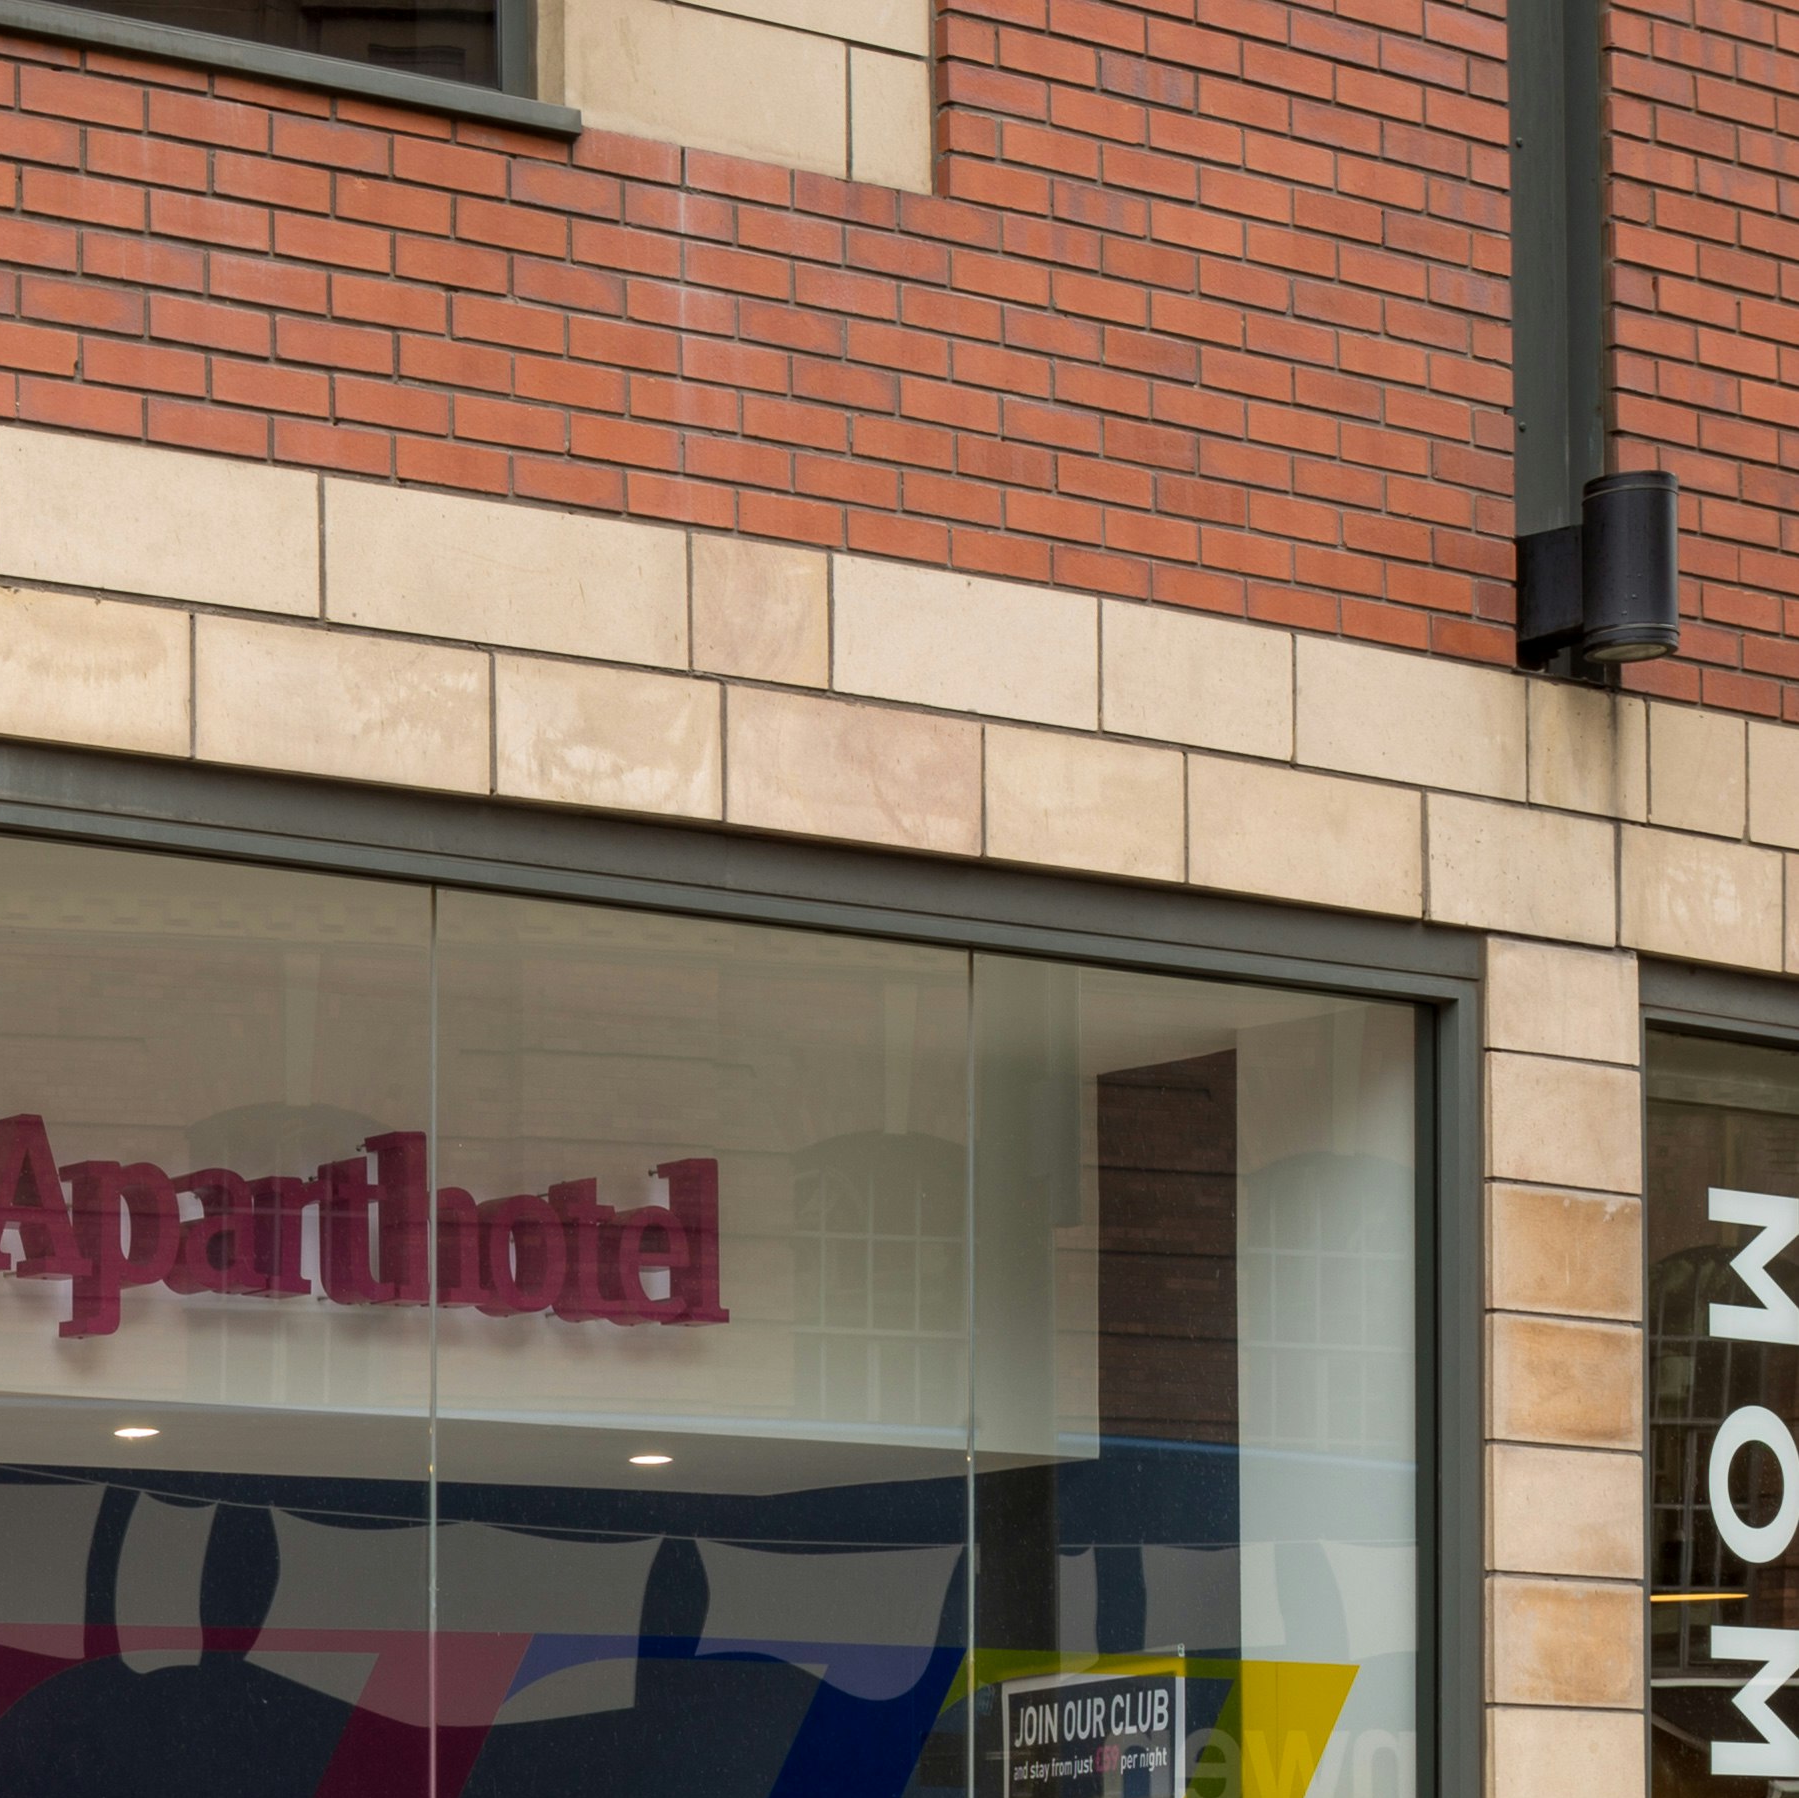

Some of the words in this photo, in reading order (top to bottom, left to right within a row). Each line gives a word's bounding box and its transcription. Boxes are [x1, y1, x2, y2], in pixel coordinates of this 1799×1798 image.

[1014, 1702, 1059, 1748] JOIN
[1063, 1696, 1106, 1742] OUR
[1110, 1688, 1169, 1736] CLUB
[1014, 1761, 1028, 1781] and
[1030, 1762, 1049, 1783] stay
[1051, 1757, 1073, 1777] from
[1073, 1755, 1093, 1780] just
[1095, 1744, 1120, 1772] £59
[1120, 1752, 1138, 1775] per
[1139, 1746, 1168, 1772] night
